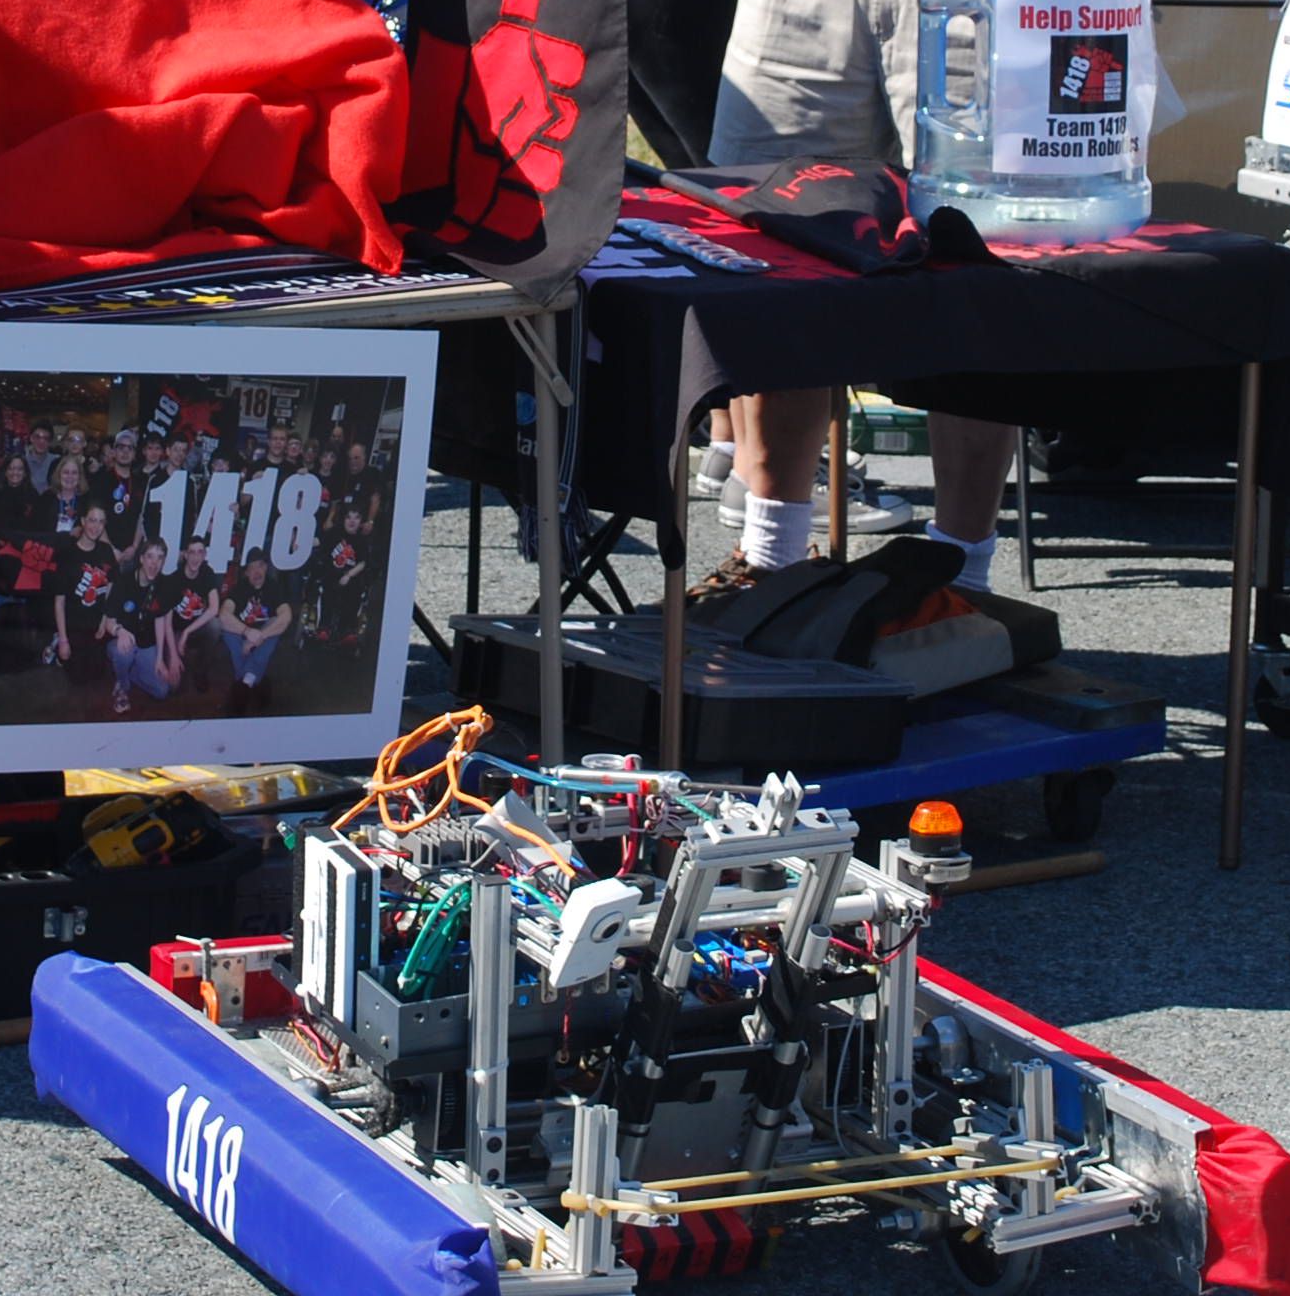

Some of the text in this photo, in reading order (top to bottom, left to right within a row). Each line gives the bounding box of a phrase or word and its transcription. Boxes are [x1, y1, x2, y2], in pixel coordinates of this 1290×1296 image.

[1020, 4, 1142, 32] Help Support
[1060, 55, 1090, 99] 1418
[1047, 115, 1127, 137] Team 1418
[1022, 137, 1083, 158] Mason
[149, 467, 323, 576] 1418
[165, 1084, 244, 1244] 1418
